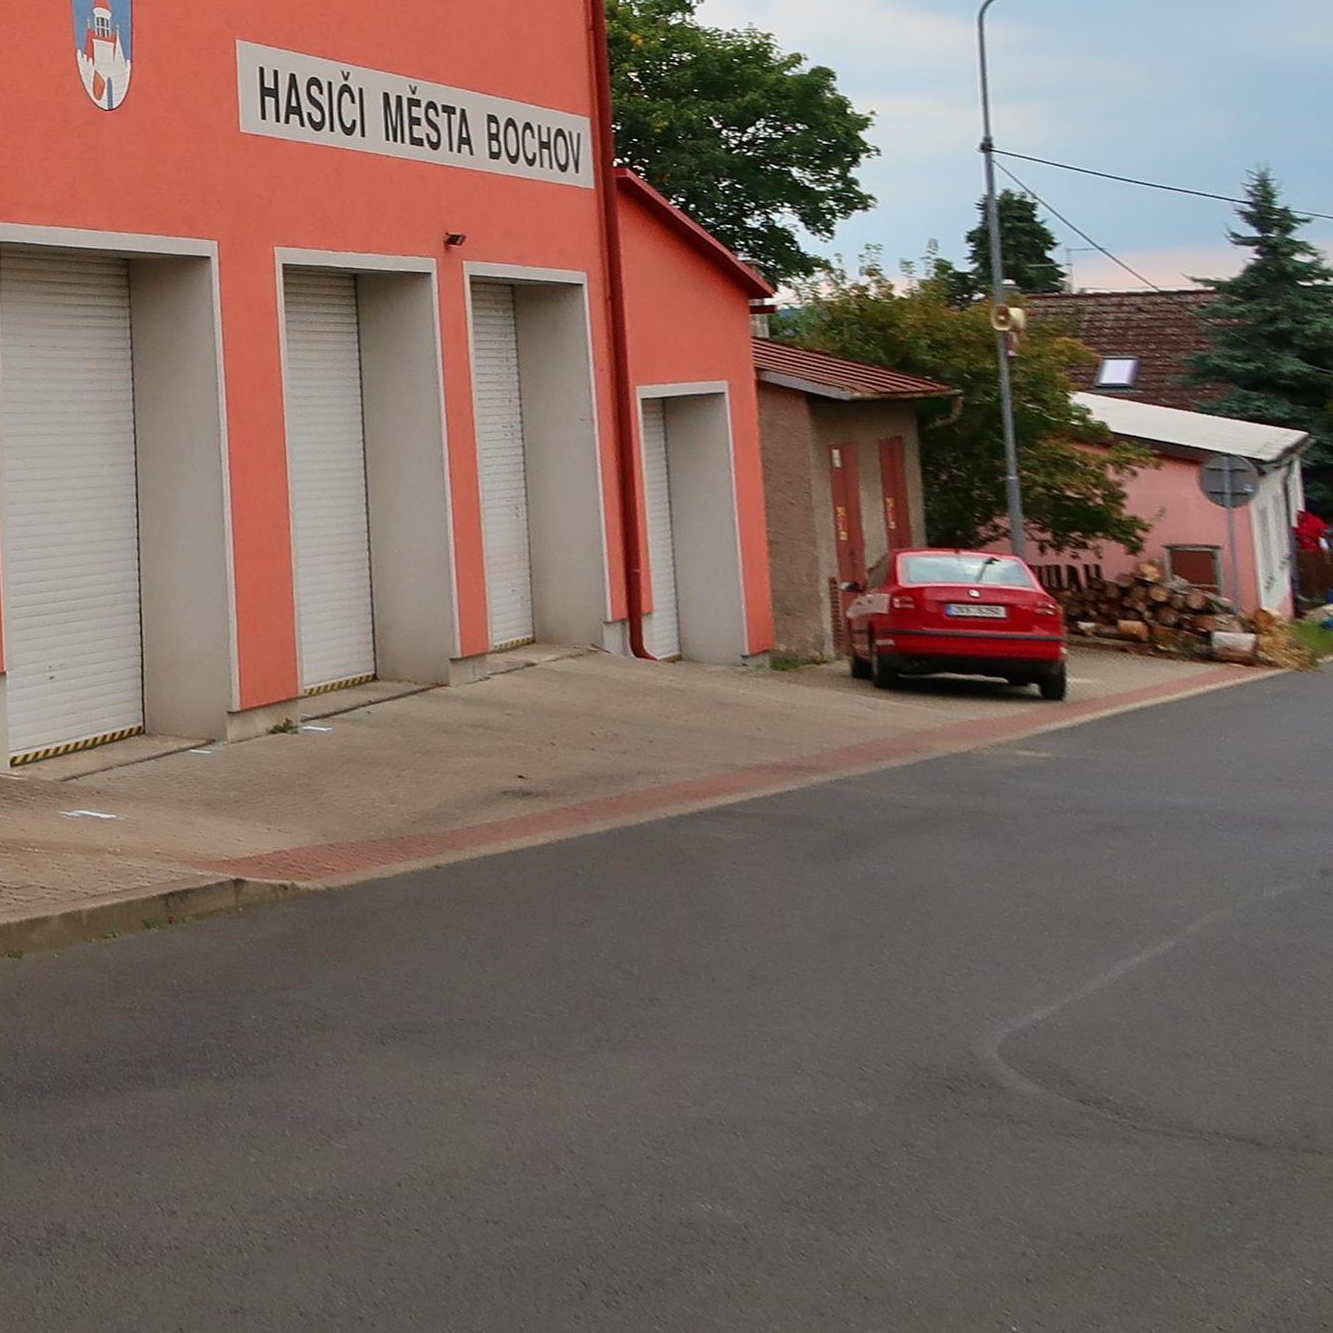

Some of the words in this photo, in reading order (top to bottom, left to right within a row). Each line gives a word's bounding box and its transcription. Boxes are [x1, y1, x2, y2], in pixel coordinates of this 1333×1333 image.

[258, 67, 366, 138] HASIČI
[382, 85, 474, 156] MĚSTA
[486, 114, 581, 174] BOCHOV
